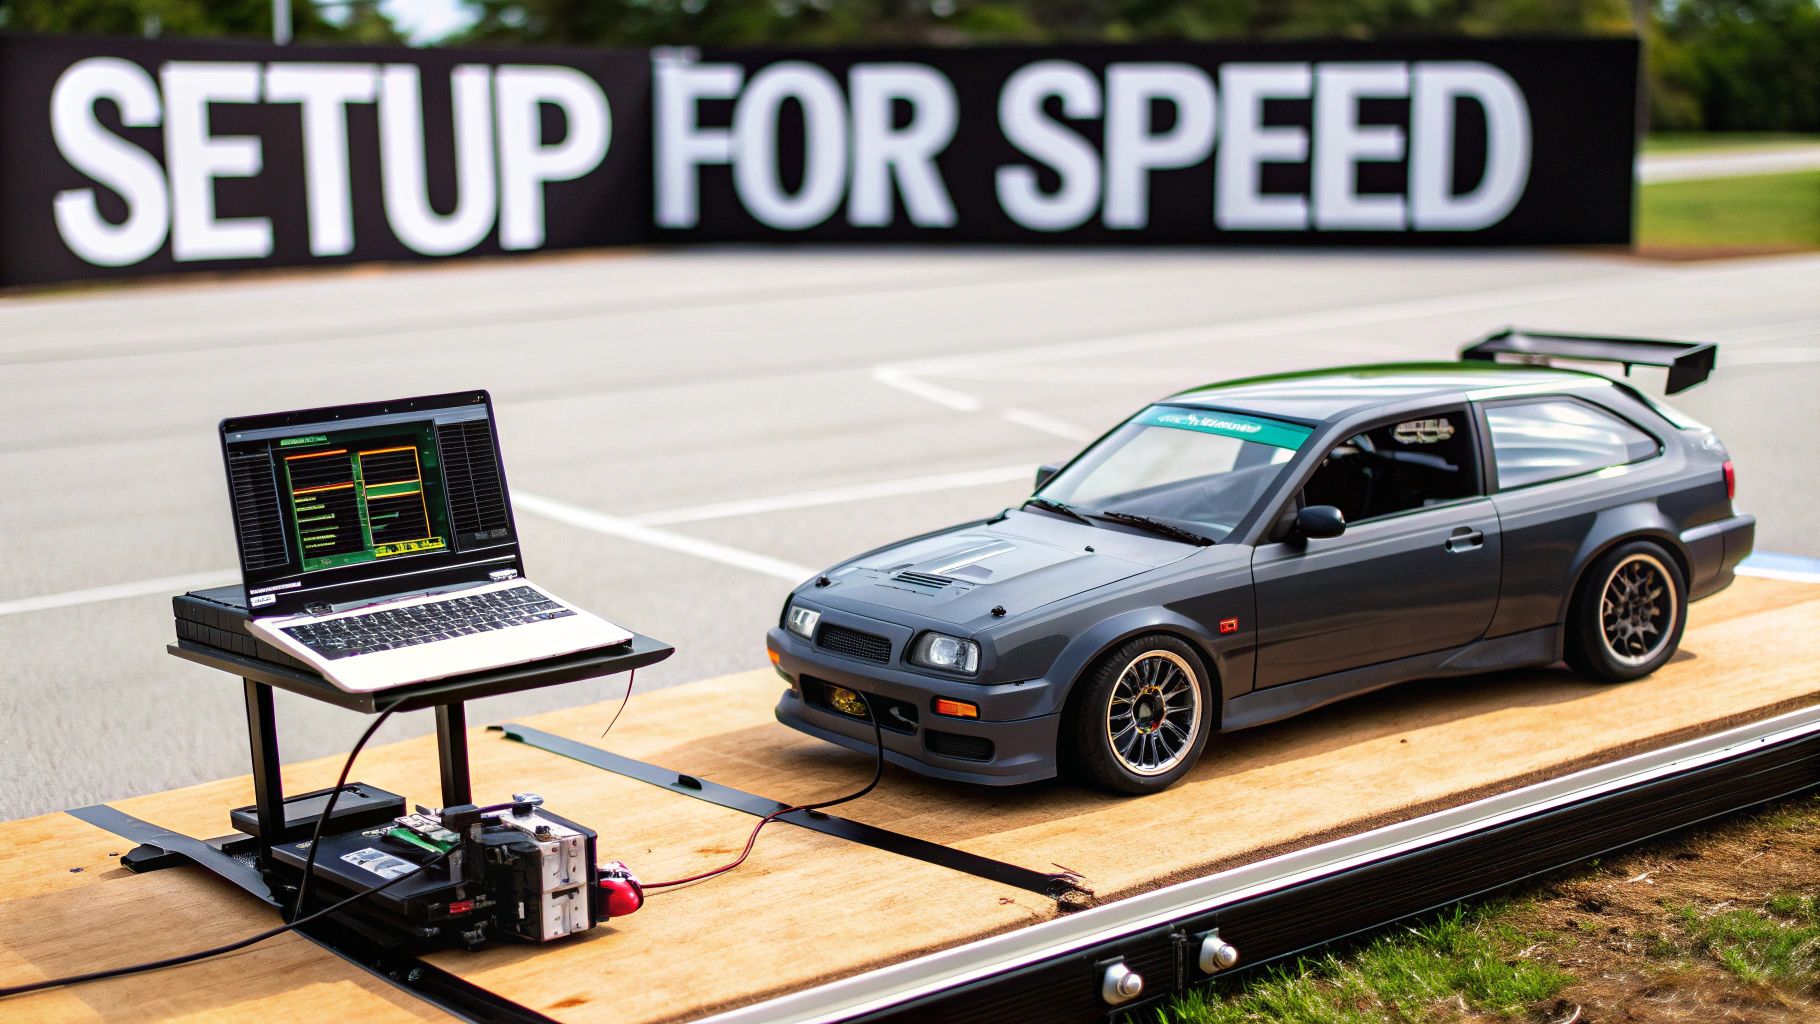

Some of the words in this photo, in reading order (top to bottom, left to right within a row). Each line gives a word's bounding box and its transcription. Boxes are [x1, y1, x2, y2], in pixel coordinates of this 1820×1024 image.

[51, 56, 612, 267] SETUP
[653, 48, 957, 229] FOR
[995, 59, 1533, 231] SPEED
